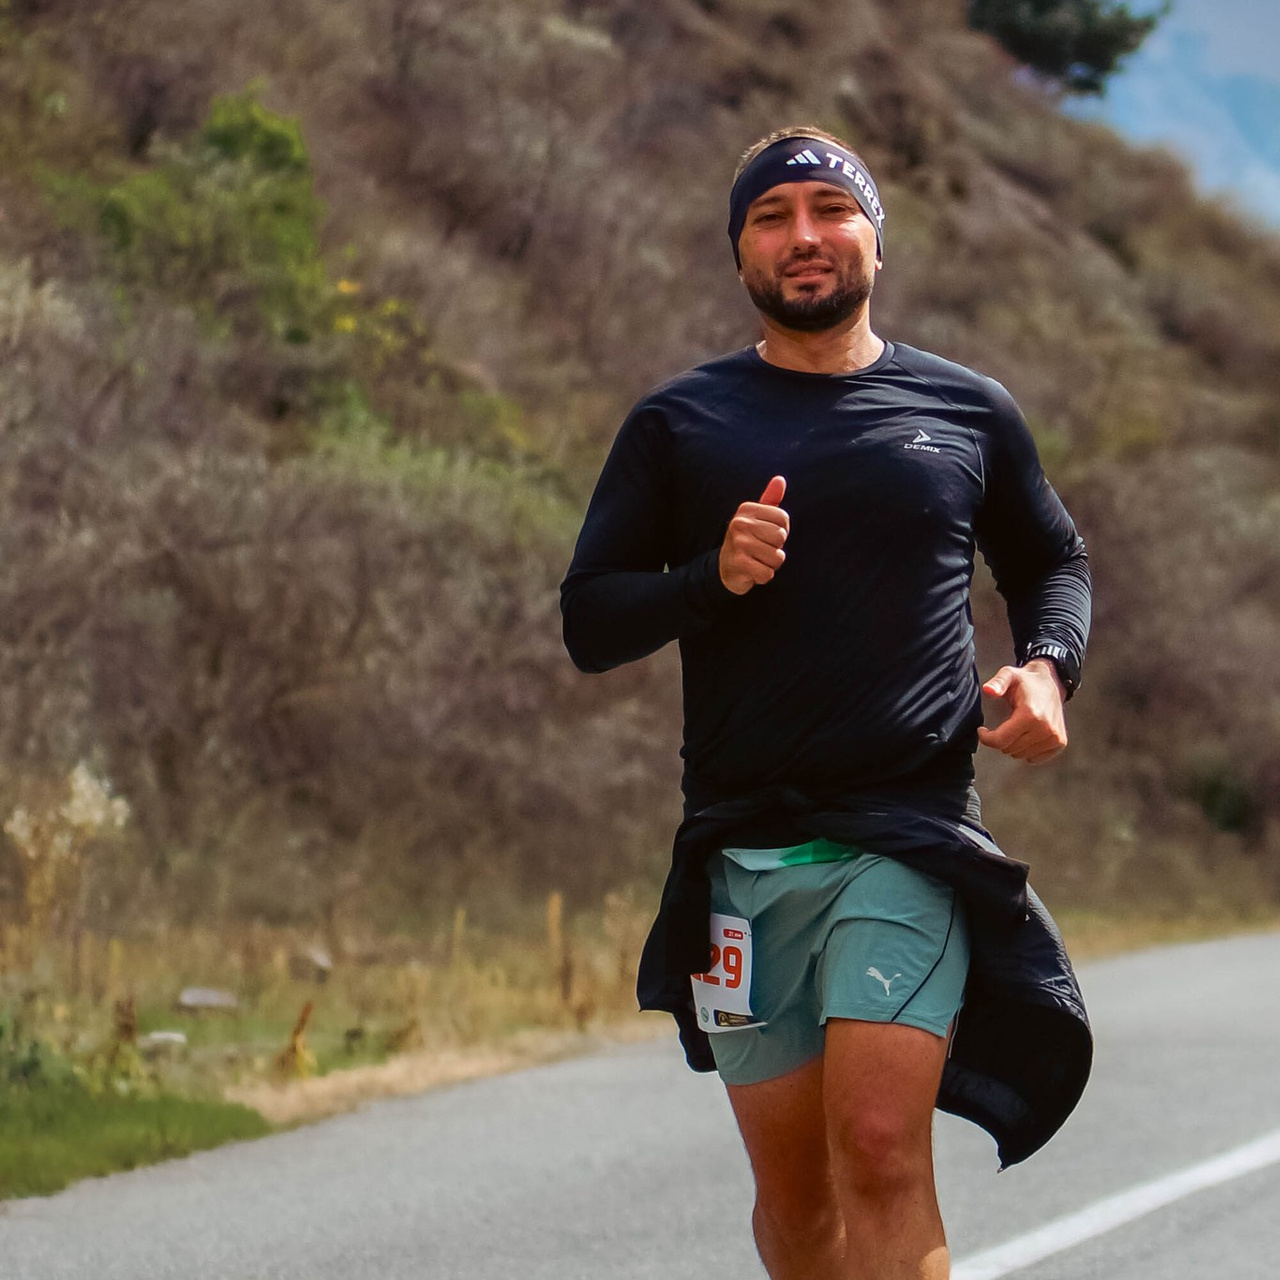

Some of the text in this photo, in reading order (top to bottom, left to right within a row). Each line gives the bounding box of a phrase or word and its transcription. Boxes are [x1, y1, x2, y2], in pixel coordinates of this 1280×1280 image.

[826, 153, 885, 228] TERREX
[903, 443, 941, 454] DEMIX
[691, 943, 742, 989] 29
